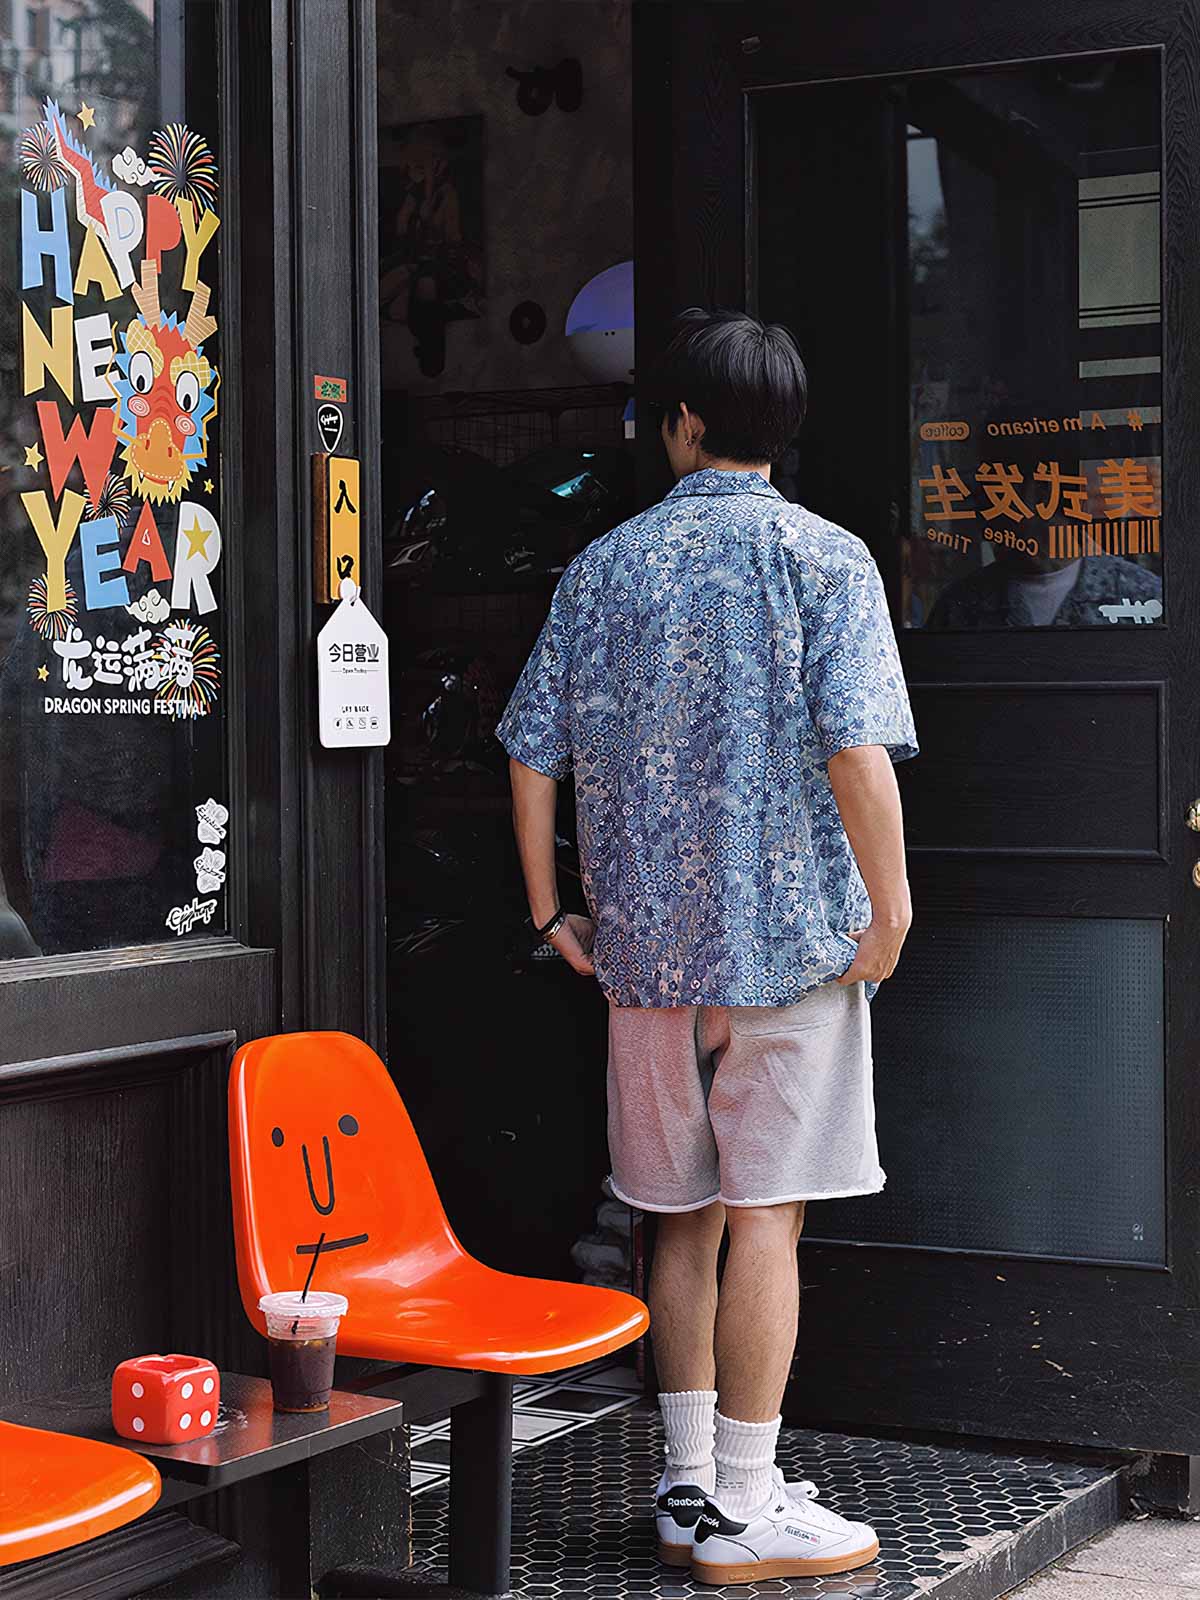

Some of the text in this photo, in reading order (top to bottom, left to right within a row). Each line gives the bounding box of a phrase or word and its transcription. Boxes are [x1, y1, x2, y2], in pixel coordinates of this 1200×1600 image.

[21, 187, 220, 304] HAPPY
[20, 488, 221, 616] YEAR
[334, 478, 358, 581] 入口
[329, 643, 380, 663] 今日营业
[44, 696, 207, 717] DRAGON SPRING FESTIVAL
